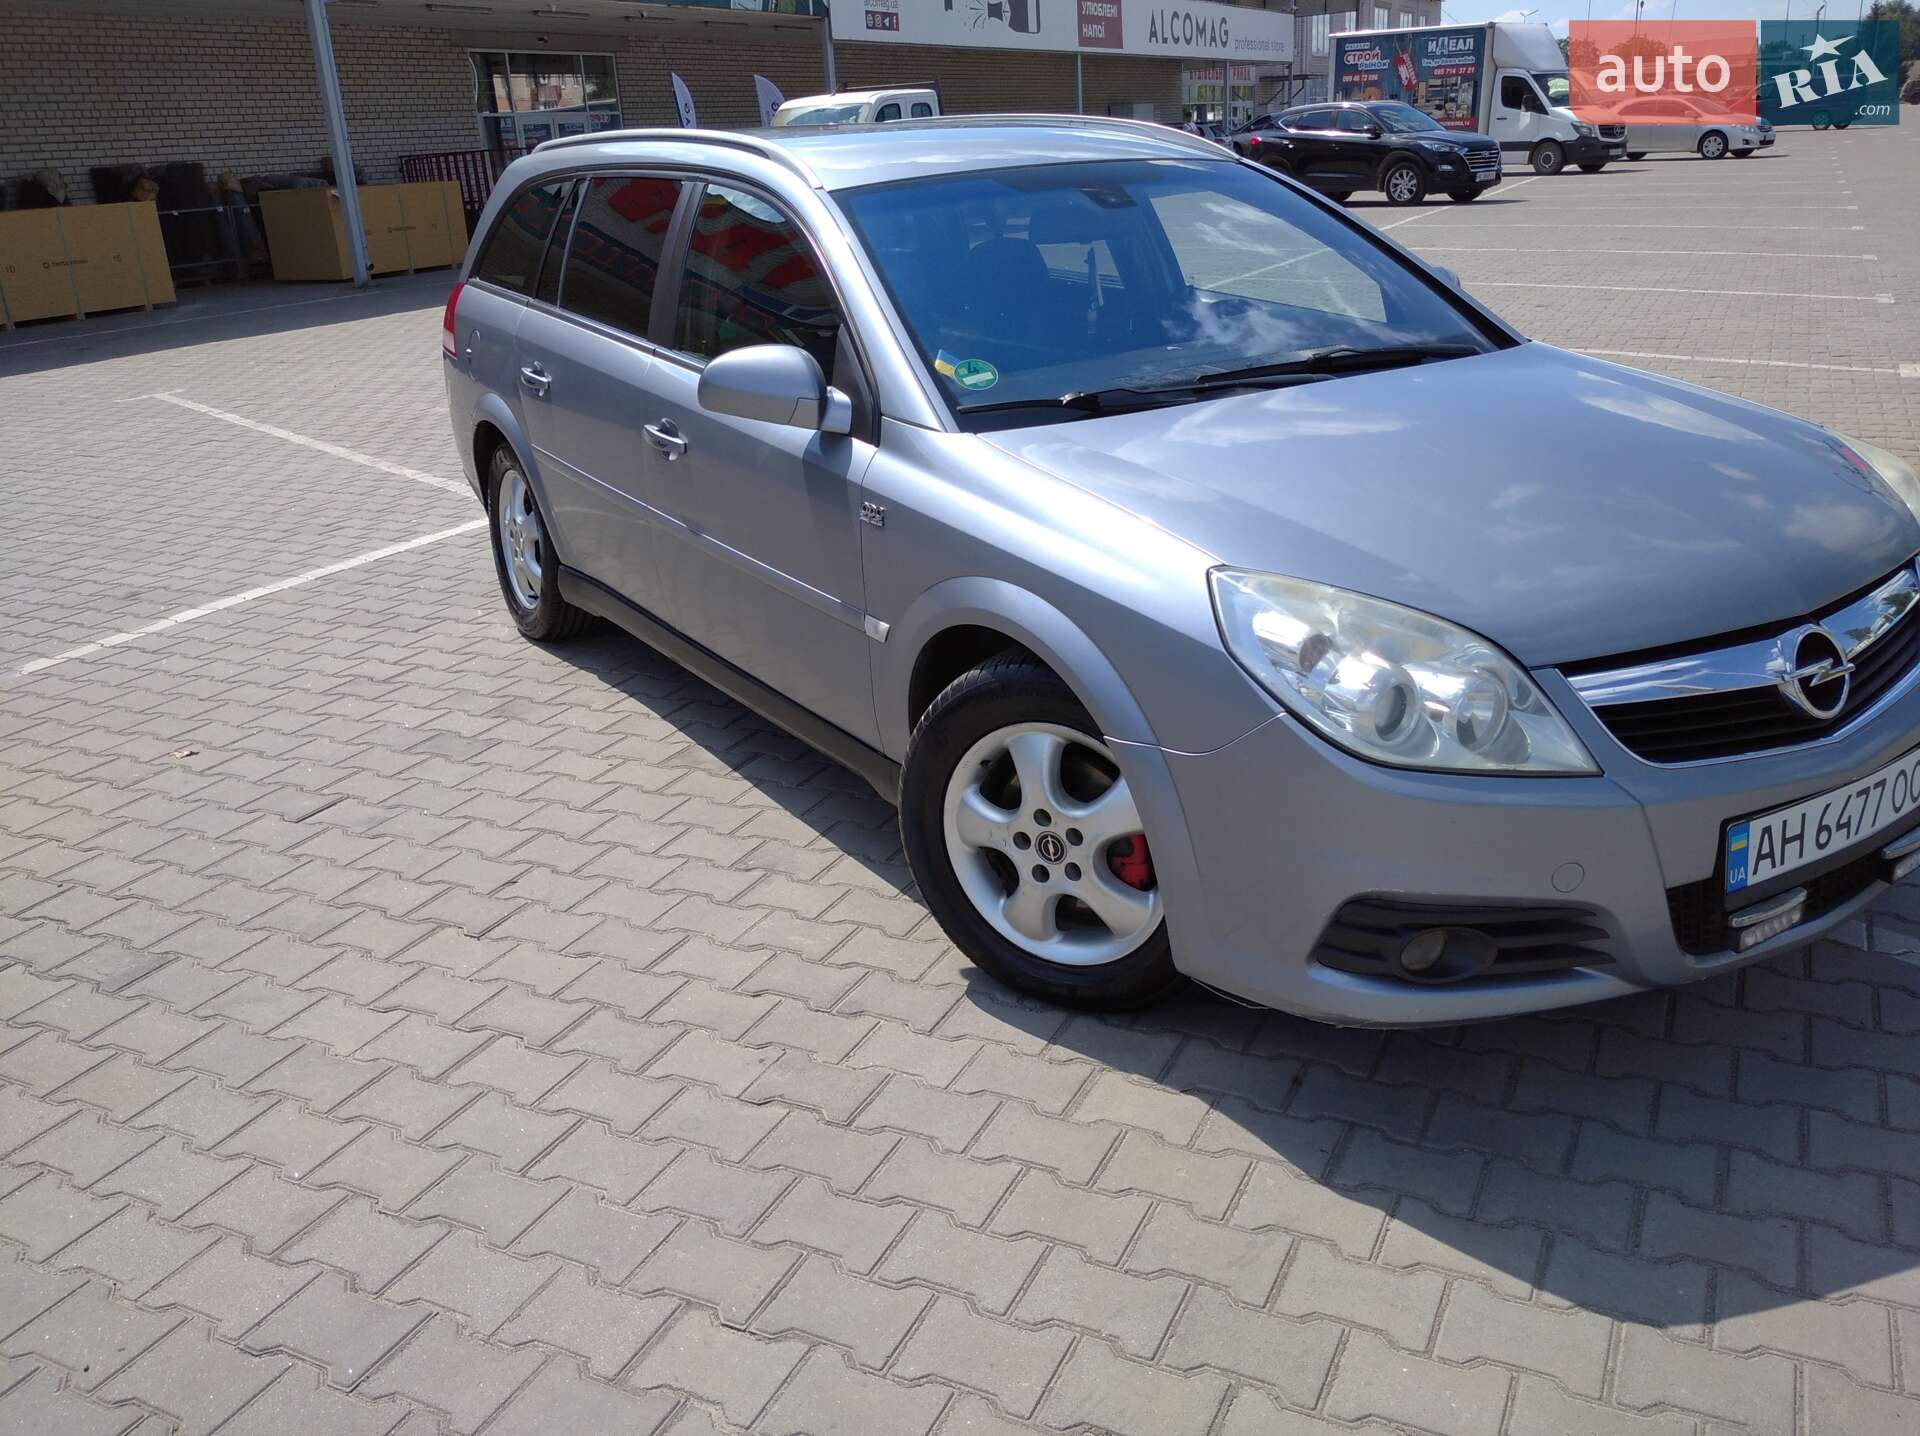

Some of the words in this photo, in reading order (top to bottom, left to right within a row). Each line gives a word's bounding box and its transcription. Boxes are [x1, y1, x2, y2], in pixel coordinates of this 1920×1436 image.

[1082, 21, 1105, 38] НАПОЇ
[1148, 9, 1229, 49] ALCOMAG
[1234, 38, 1270, 52] professional
[1271, 40, 1285, 52] store
[1428, 37, 1474, 55] ИДЕАЛ
[1344, 47, 1381, 64] СТРОЙ
[1752, 813, 1806, 876] AH
[1814, 778, 1887, 850] 6477
[1729, 866, 1747, 884] UA
